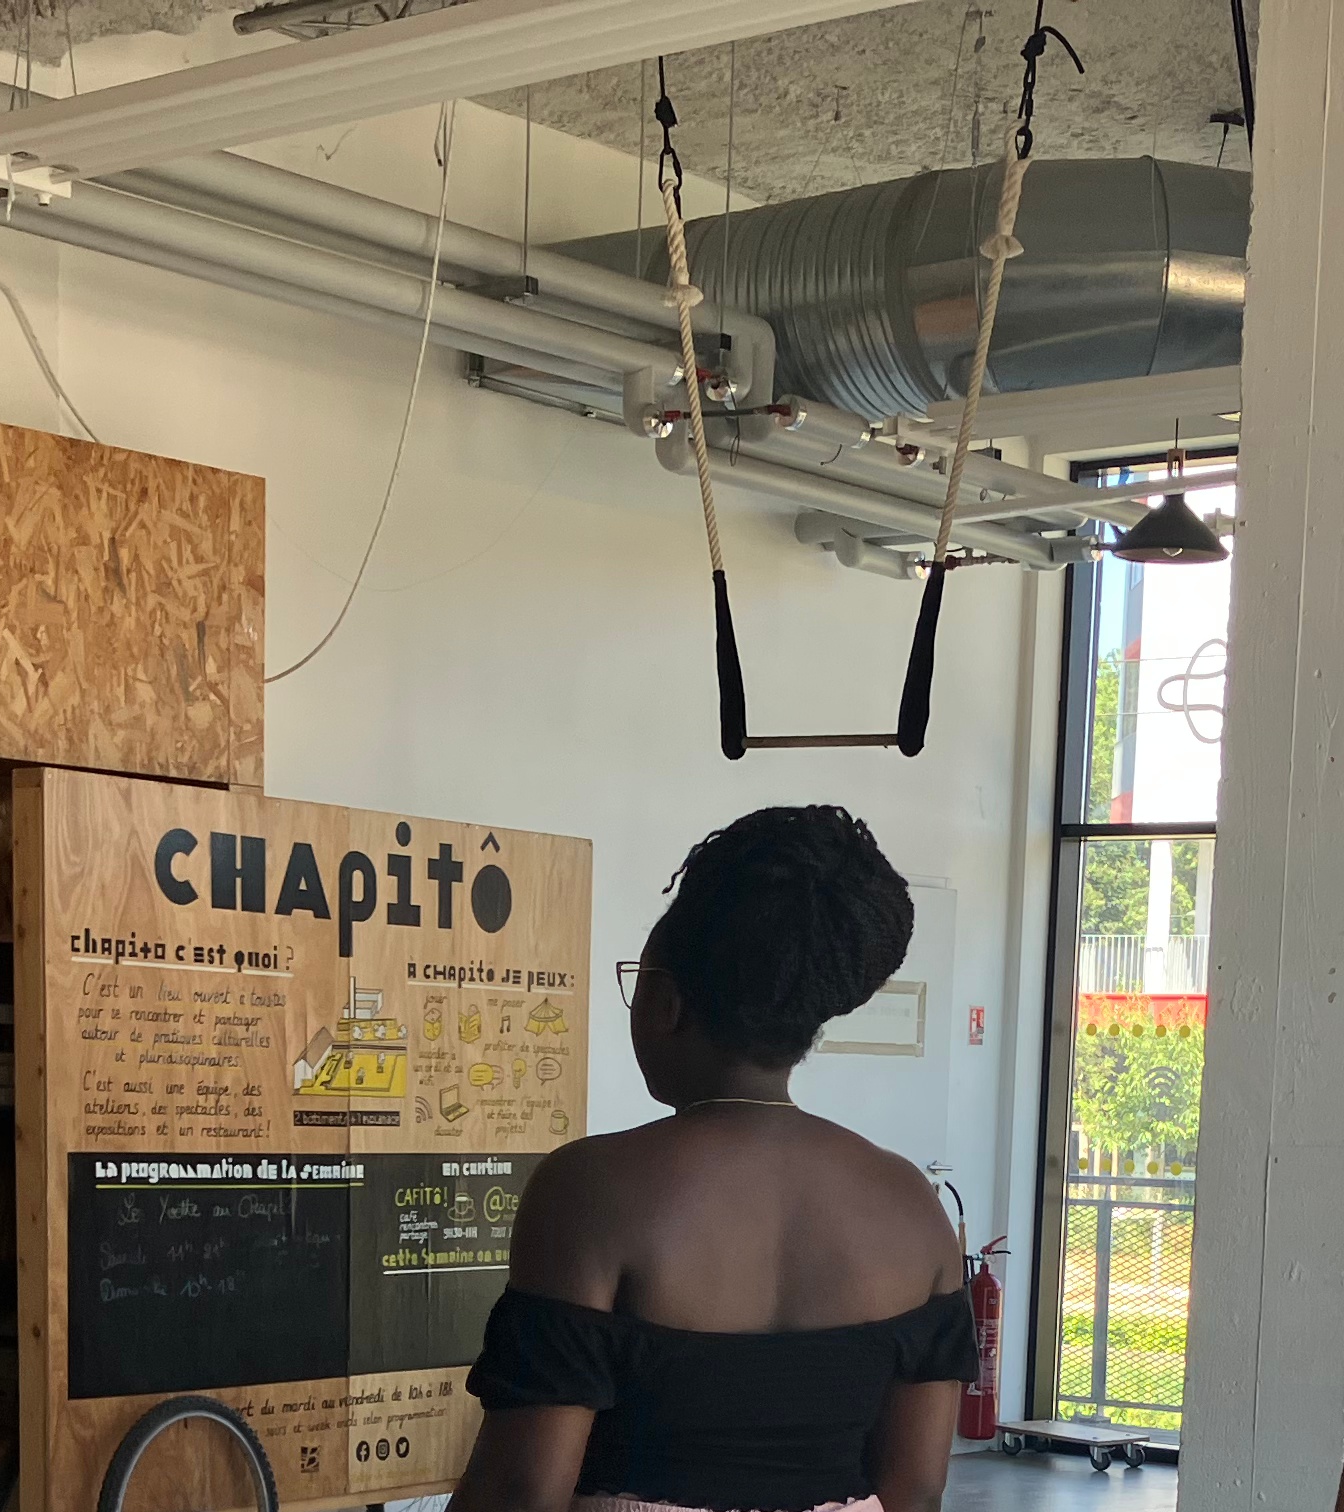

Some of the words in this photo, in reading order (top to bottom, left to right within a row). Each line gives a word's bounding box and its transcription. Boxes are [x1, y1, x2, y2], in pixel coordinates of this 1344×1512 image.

[129, 985, 144, 999] un
[78, 1007, 104, 1025] pour
[129, 1009, 185, 1023] rencontrer
[193, 1009, 206, 1024] et
[214, 1011, 262, 1033] partager
[82, 1024, 118, 1041] autour
[129, 1027, 143, 1043] de
[153, 1030, 203, 1049] pratiques
[212, 1030, 271, 1049] culturelles
[114, 1050, 126, 1063] et
[123, 1079, 154, 1094] aussi
[166, 1082, 184, 1094] une
[242, 1082, 262, 1096] des
[243, 1102, 263, 1117] des
[86, 1120, 146, 1142] expositions
[156, 1123, 169, 1137] et
[179, 1125, 194, 1138] un
[261, 1399, 275, 1415] du
[282, 1397, 315, 1413] mardi
[321, 1398, 336, 1410] au
[391, 1384, 403, 1402] de
